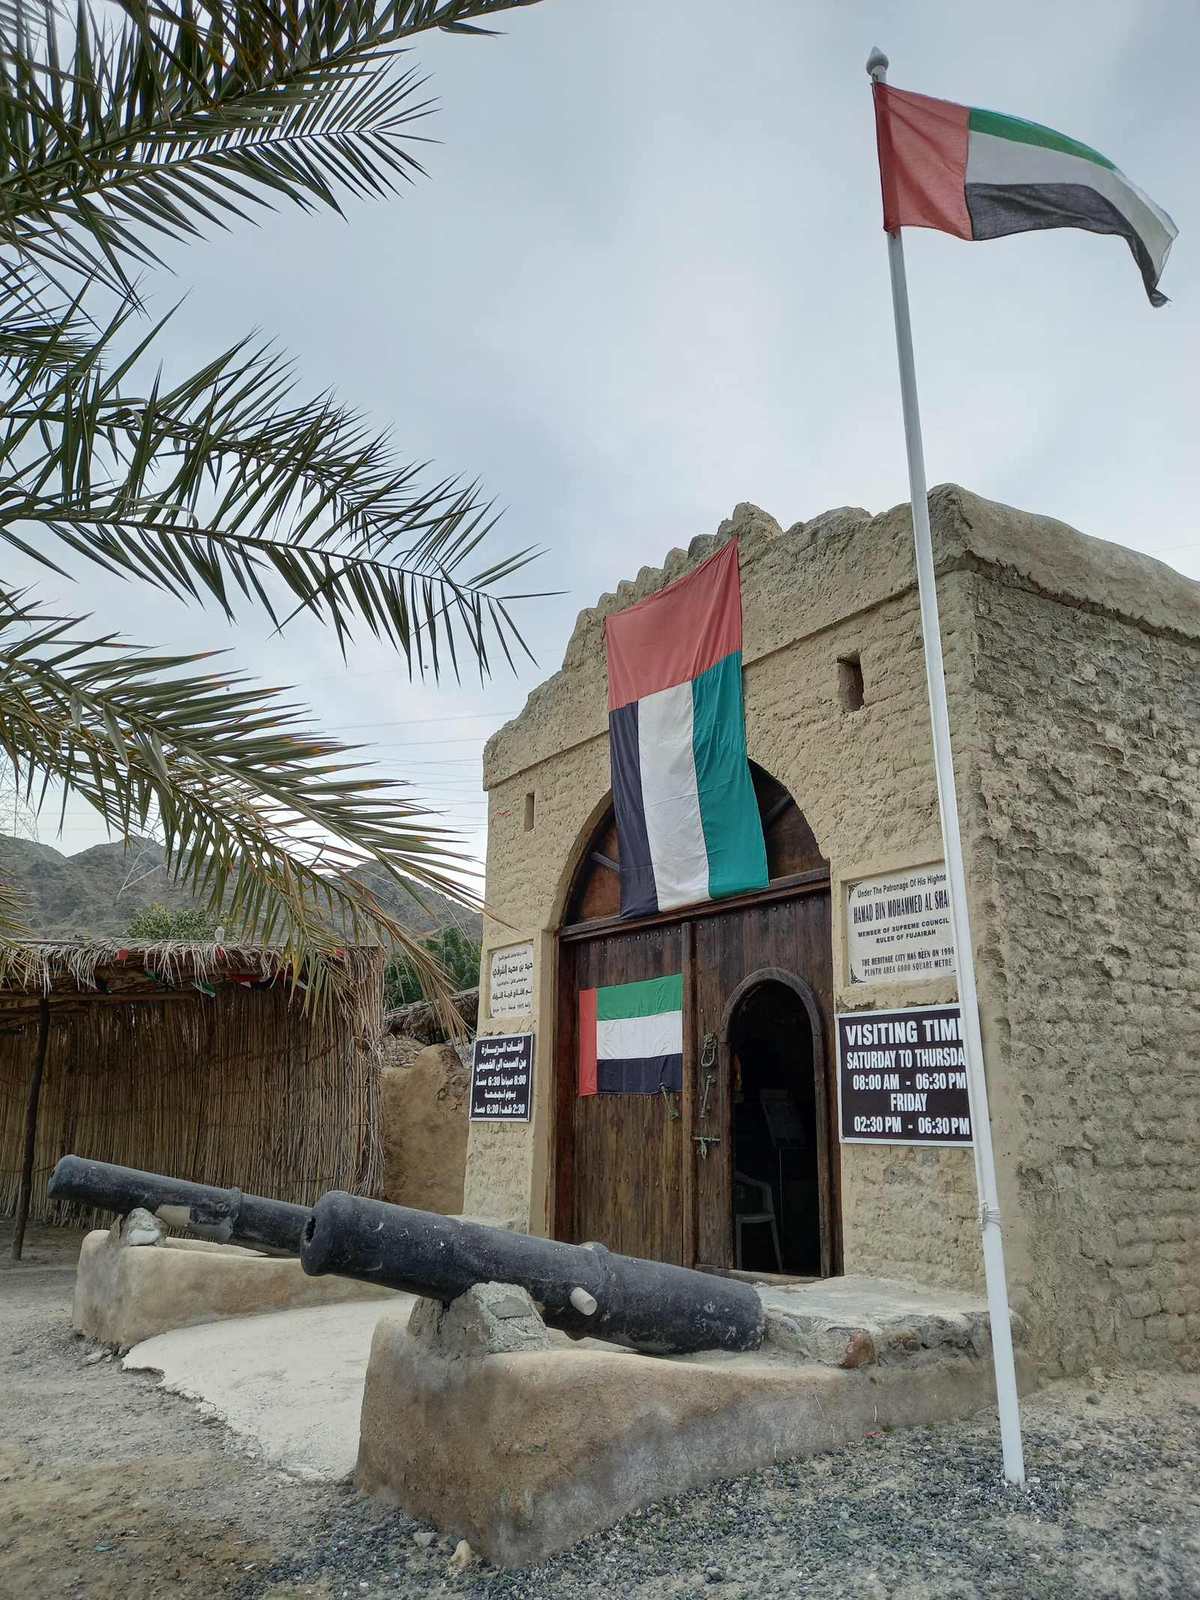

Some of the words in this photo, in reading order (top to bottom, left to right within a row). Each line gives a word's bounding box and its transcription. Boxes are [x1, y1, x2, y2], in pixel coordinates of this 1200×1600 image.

[857, 888, 872, 898] Under
[873, 886, 882, 896] The
[883, 882, 908, 893] Patronage
[909, 879, 916, 888] Of
[917, 877, 926, 887] His
[853, 903, 873, 924] HAMAD
[875, 901, 886, 920] BIN
[887, 894, 922, 918] MOHAMMED
[925, 892, 933, 912] AL
[858, 928, 881, 937] MEMBER
[892, 922, 920, 932] SUPREME
[921, 918, 950, 927] COUNCIL
[876, 936, 894, 944] RULER
[905, 929, 936, 939] FUJAIRAH
[861, 958, 870, 967] THE
[871, 955, 893, 966] HERITAGE
[895, 953, 905, 963] CITY
[907, 951, 917, 961] HAS
[918, 949, 930, 959] BEEN
[932, 948, 939, 957] ON
[883, 965, 896, 974] AREA
[912, 960, 933, 971] SQUARE
[845, 1021, 918, 1046] VISITING
[846, 1050, 897, 1070] SATURDAY
[898, 1049, 912, 1068] TO
[488, 1076, 500, 1086] 6:30
[853, 1074, 881, 1090] 08:00
[883, 1074, 900, 1090] AM
[915, 1072, 946, 1090] 06:30
[948, 1072, 967, 1089] PM
[890, 1093, 928, 1112] FRIDAY
[854, 1116, 883, 1132] 02:30
[885, 1116, 902, 1133] PM
[918, 1117, 949, 1134] 06:30
[950, 1117, 970, 1135] PM
